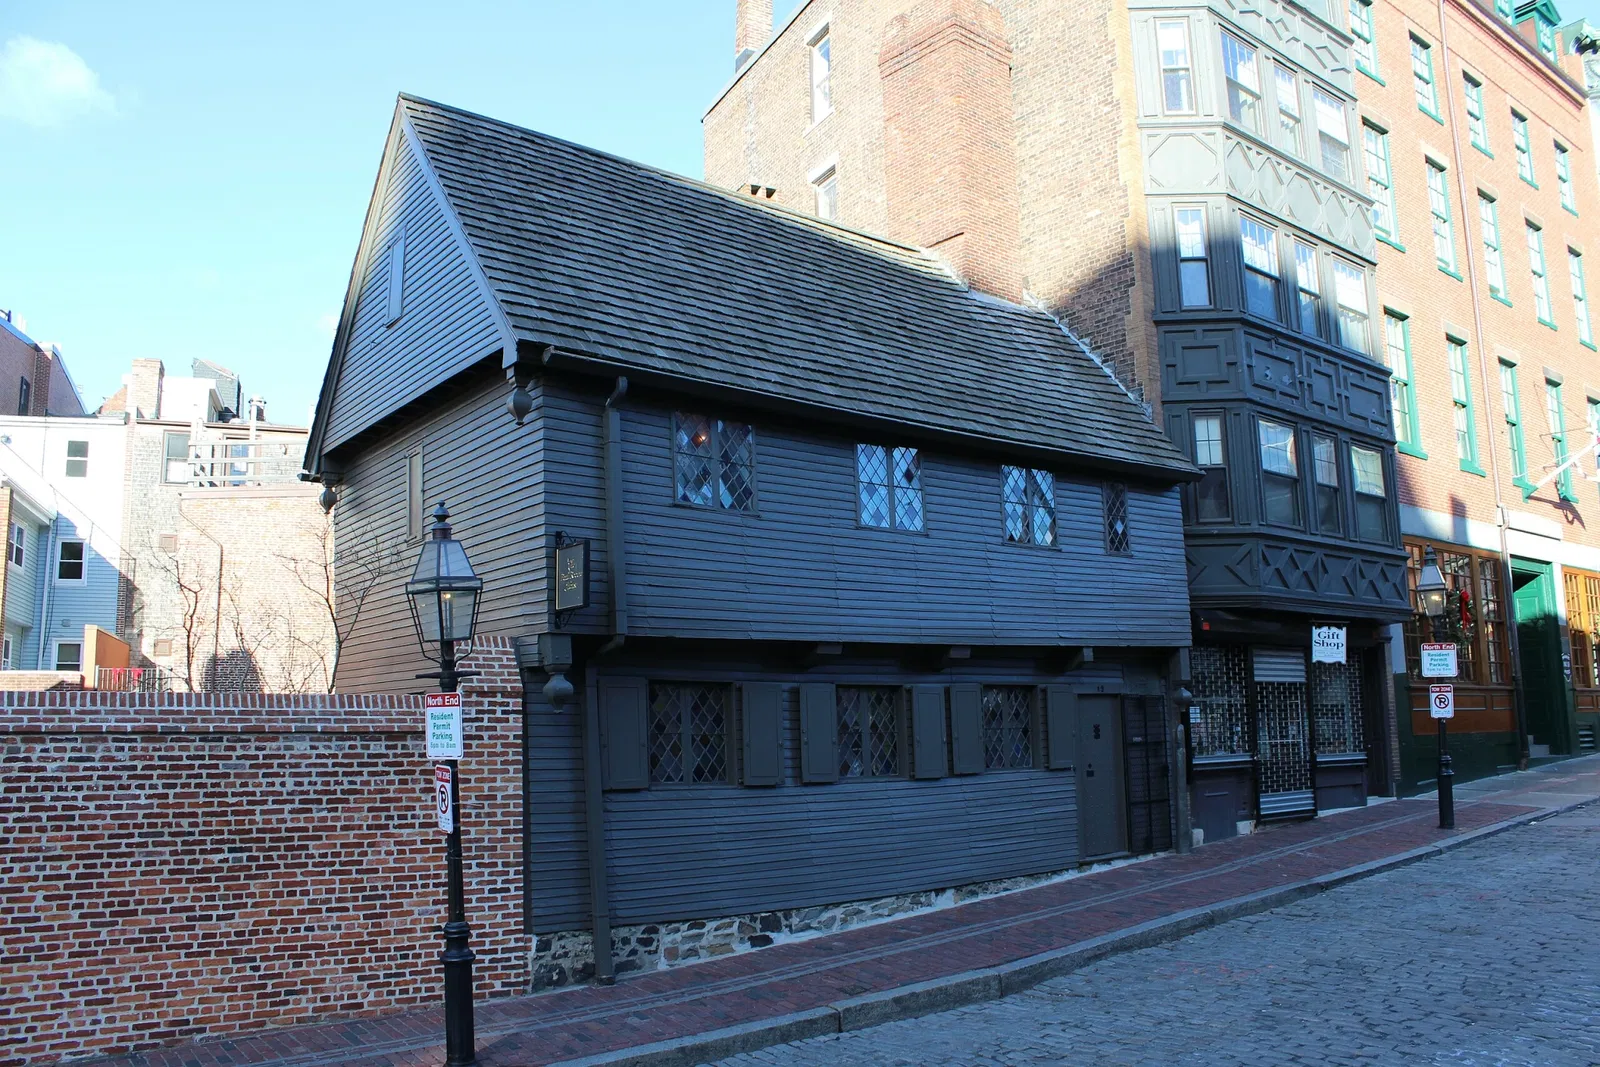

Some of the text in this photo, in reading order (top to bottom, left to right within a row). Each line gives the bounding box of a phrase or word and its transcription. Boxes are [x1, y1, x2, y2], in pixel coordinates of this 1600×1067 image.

[1317, 631, 1340, 639] Gift
[1313, 639, 1344, 650] Shop
[427, 695, 459, 706] North End
[430, 712, 454, 720] Resident
[433, 722, 451, 730] Permit
[432, 732, 453, 741] Parking
